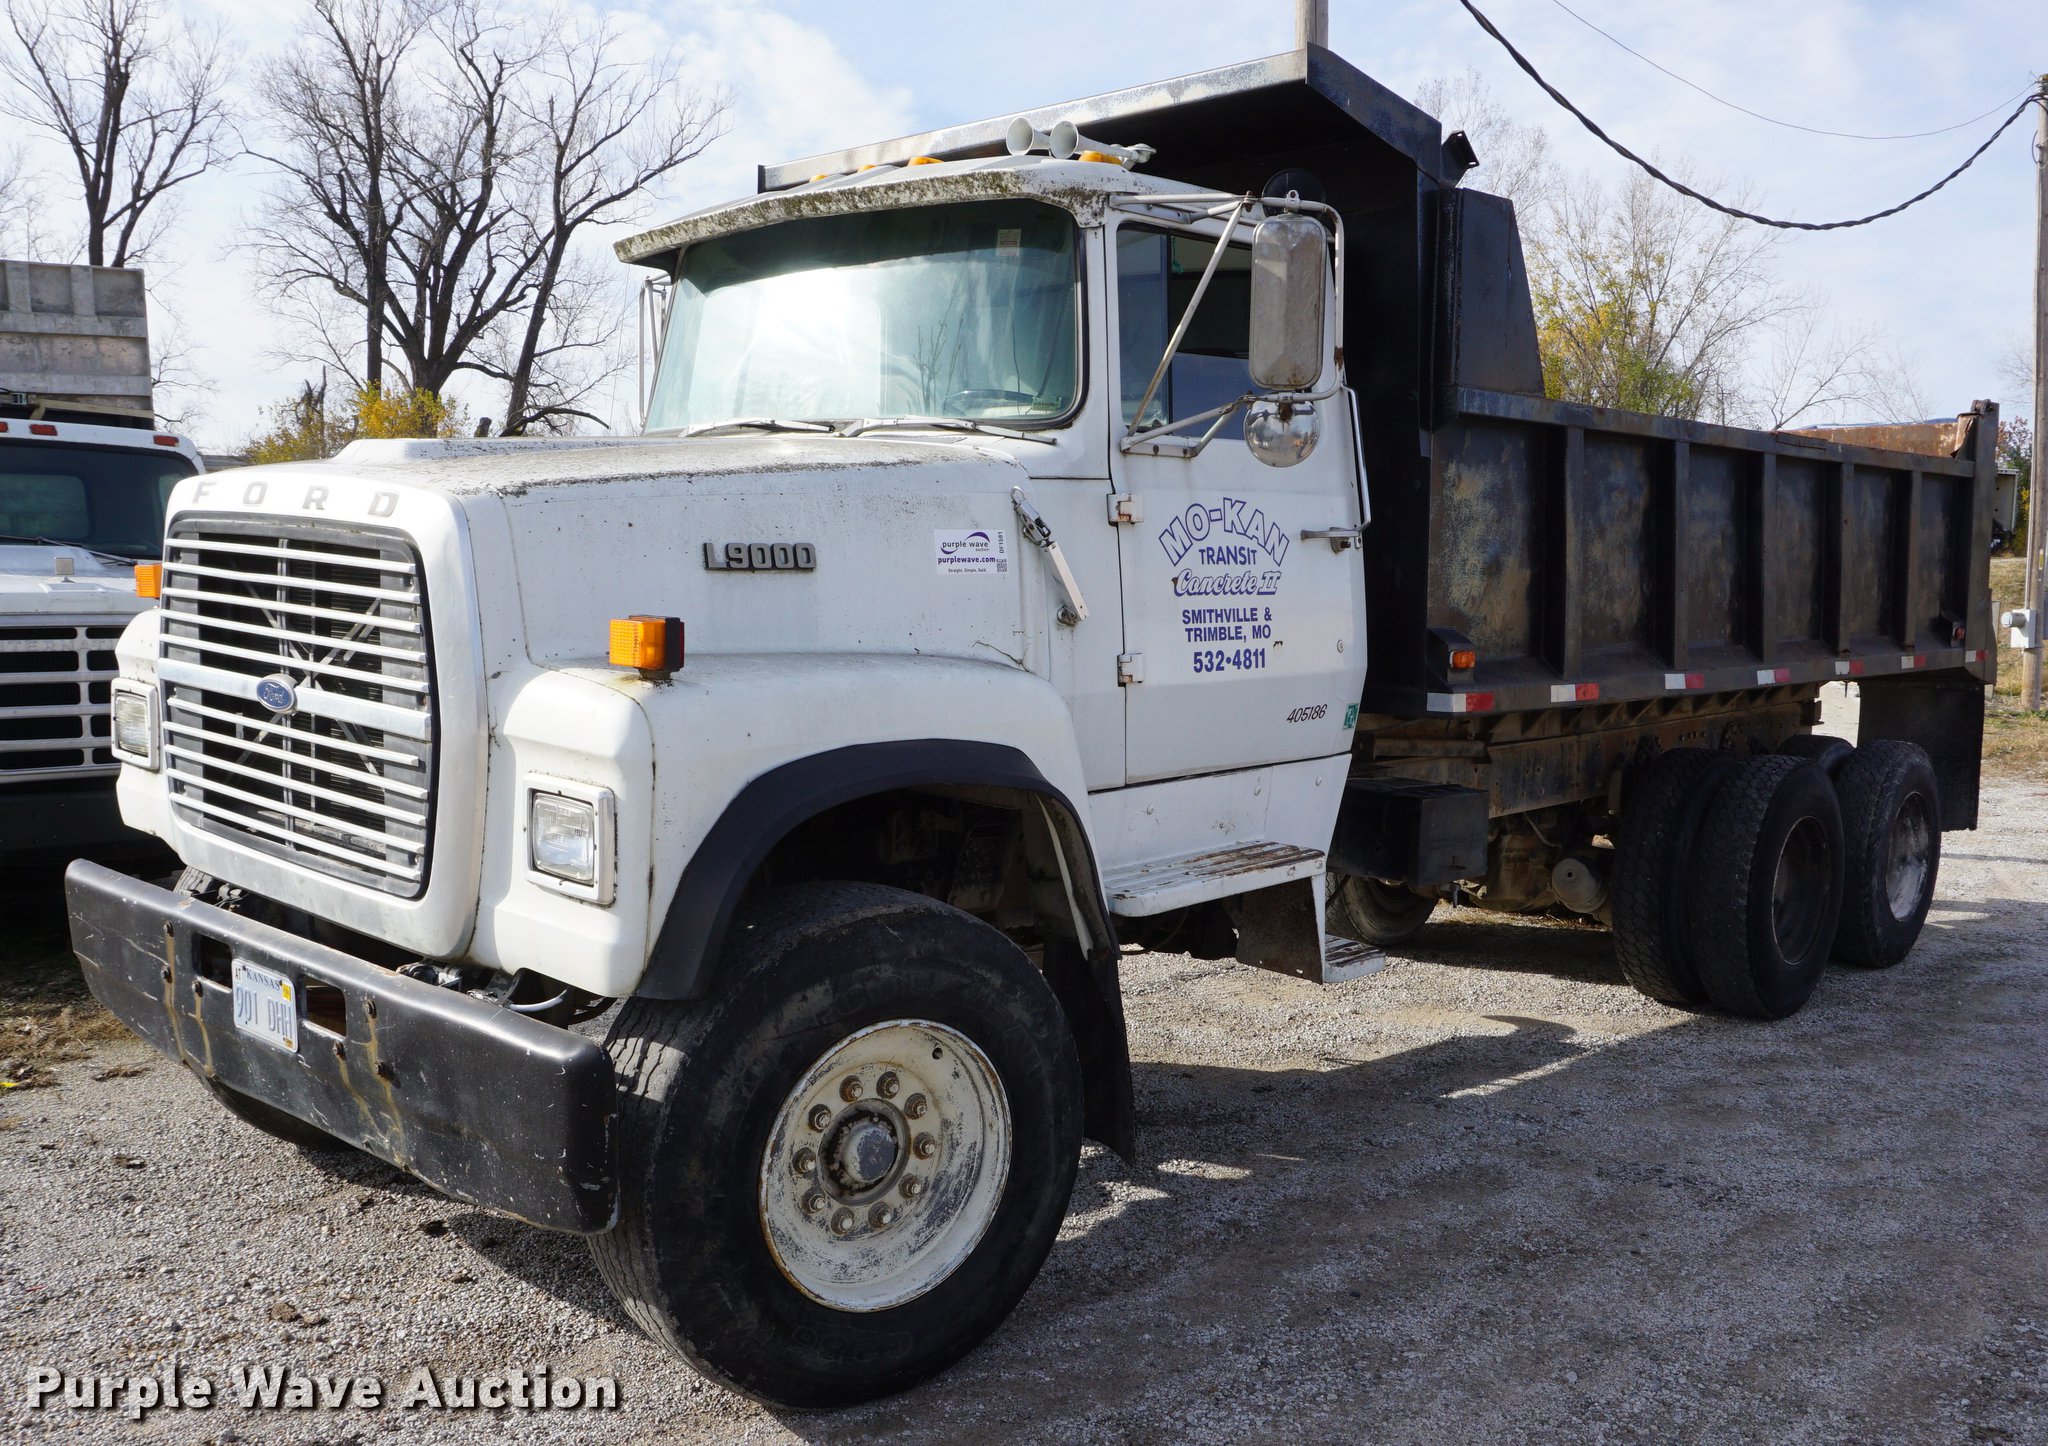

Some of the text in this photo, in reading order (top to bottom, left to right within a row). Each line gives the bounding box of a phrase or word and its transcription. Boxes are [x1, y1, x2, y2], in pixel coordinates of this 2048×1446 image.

[192, 481, 399, 518] FORD
[1158, 497, 1289, 567] MO-KAN
[942, 540, 966, 549] purple
[1199, 545, 1257, 566] TRANSIT
[703, 542, 816, 570] L9000
[937, 556, 996, 565] purplewave.com
[1173, 567, 1258, 597] Concrete
[1182, 606, 1273, 624] SMITHVILLE &
[1185, 624, 1271, 643] TRIMBLE, MO
[1287, 703, 1328, 724] 405186
[246, 968, 281, 991] KANSAS
[235, 986, 258, 1025] 901
